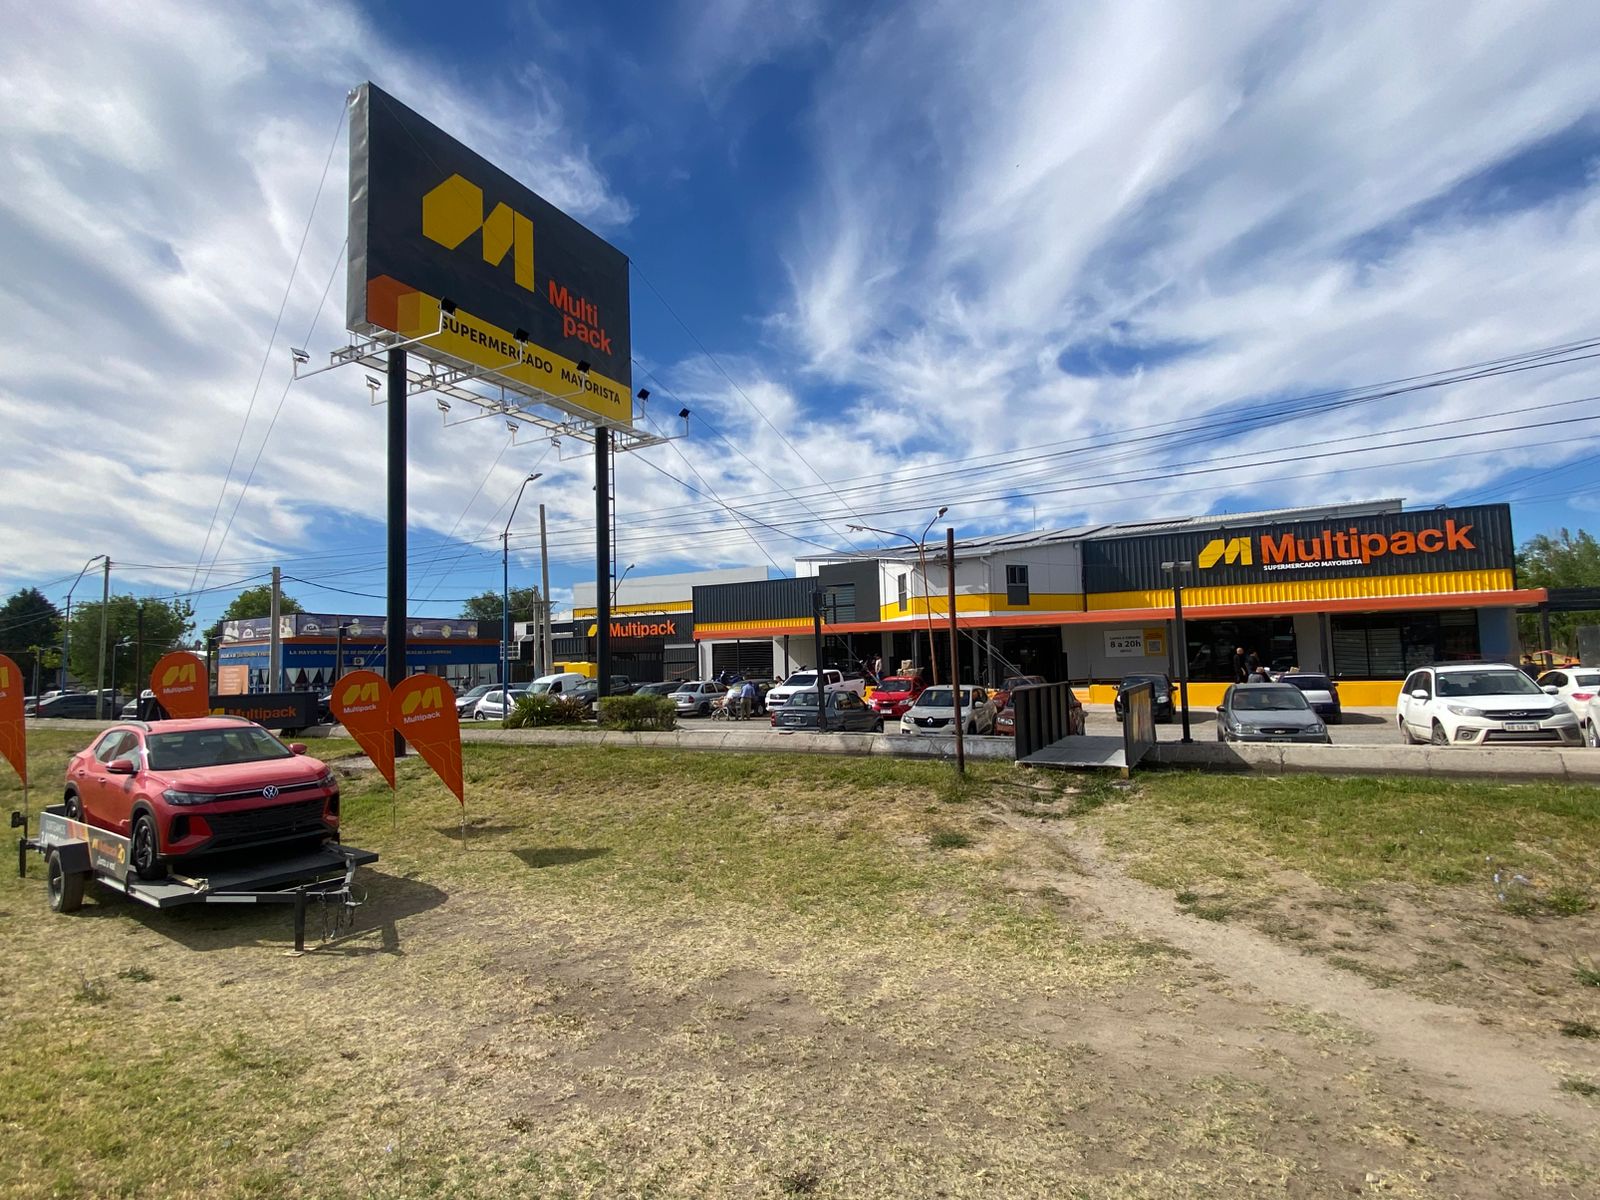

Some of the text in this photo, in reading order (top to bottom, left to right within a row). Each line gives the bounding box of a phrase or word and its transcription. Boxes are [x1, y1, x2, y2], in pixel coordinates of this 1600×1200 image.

[549, 279, 599, 328] Multi
[563, 315, 612, 356] pack
[442, 316, 621, 405] SUPERMERCADO MAYORISTA
[1261, 519, 1476, 565] Multipack
[1263, 558, 1363, 571] SUPERMERCADO MAYORISTA
[610, 620, 676, 638] Multipack
[344, 704, 377, 714] Multipack
[403, 711, 440, 725] Multipack
